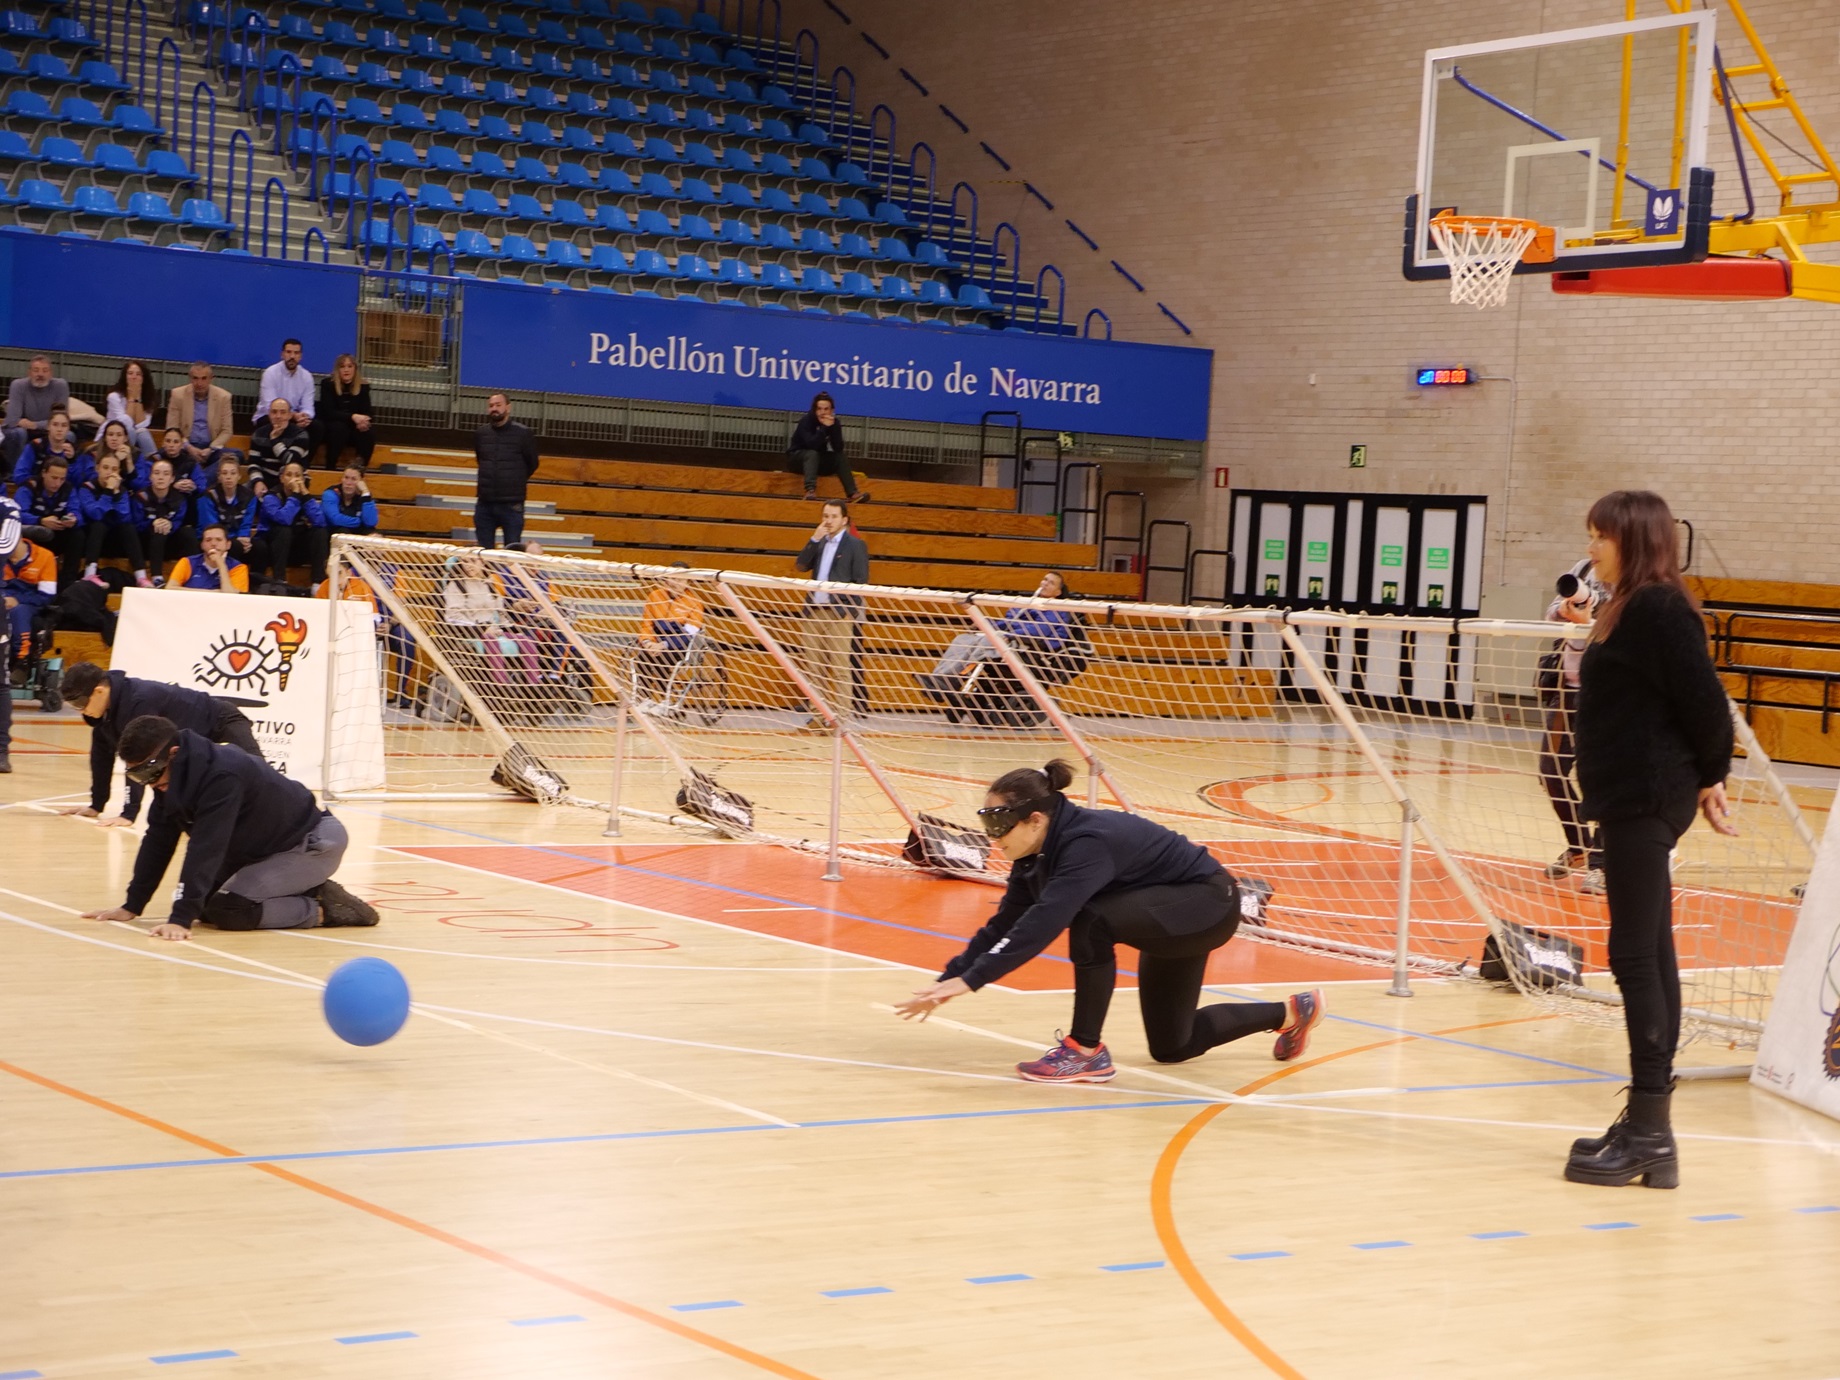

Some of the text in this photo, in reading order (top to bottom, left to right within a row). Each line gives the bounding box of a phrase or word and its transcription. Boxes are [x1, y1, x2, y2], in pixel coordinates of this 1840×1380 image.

[588, 332, 1102, 406] Pabellón Universitario de Navarra
[254, 720, 295, 735] TIVO
